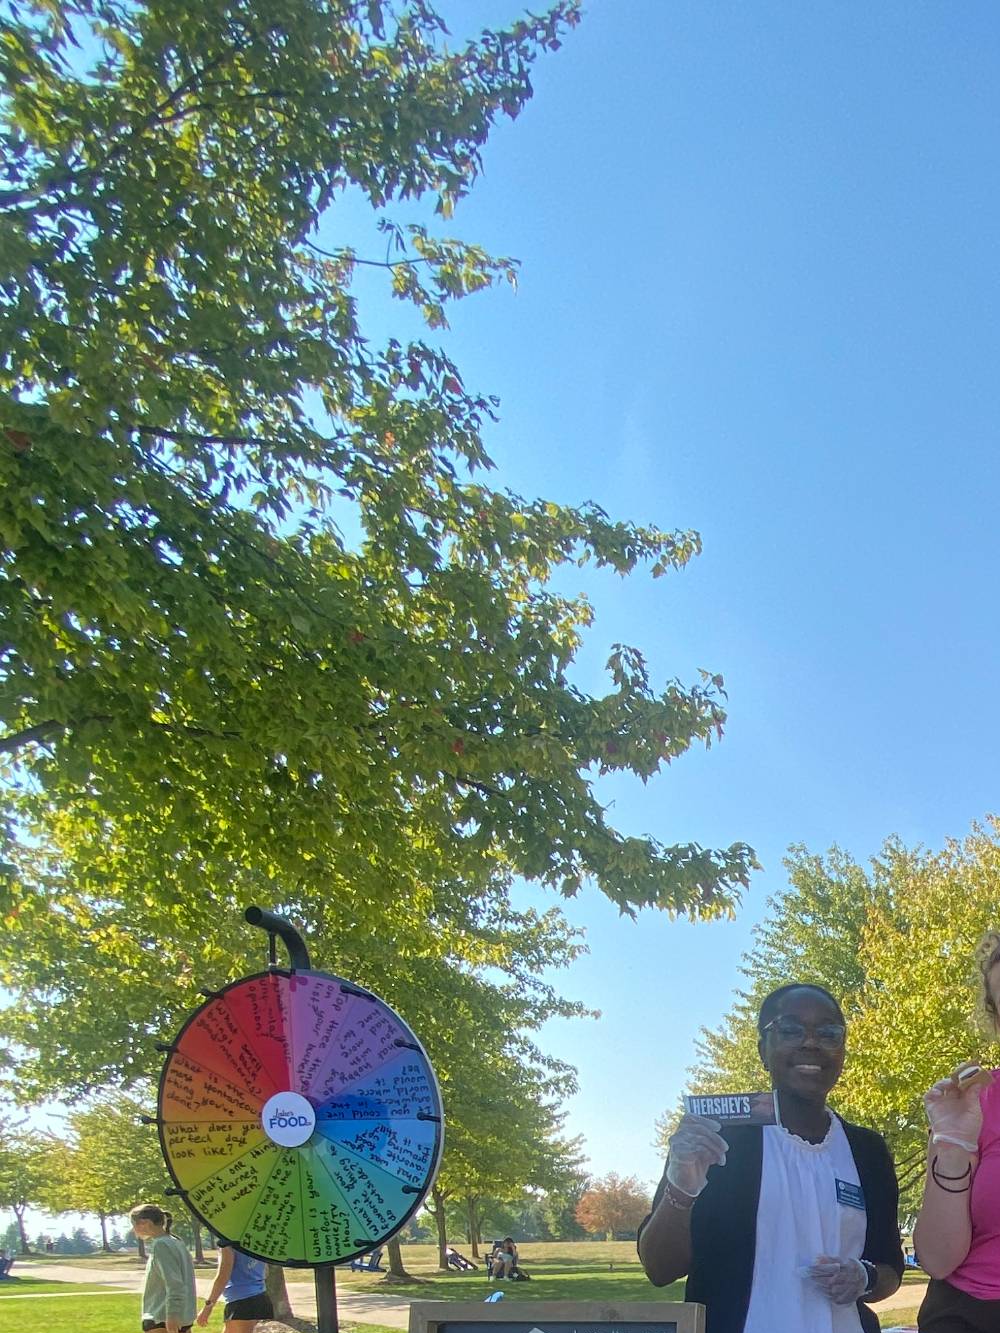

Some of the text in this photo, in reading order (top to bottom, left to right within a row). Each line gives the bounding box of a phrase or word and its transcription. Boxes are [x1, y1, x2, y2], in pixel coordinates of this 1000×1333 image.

[285, 982, 324, 1014] list?
[324, 985, 334, 998] on
[215, 1003, 237, 1034] What
[312, 1010, 324, 1035] your
[357, 1009, 380, 1028] time
[206, 1010, 257, 1080] brings back
[318, 1020, 338, 1048] three
[340, 1018, 390, 1058] had more
[324, 1024, 396, 1086] you wish you
[174, 1058, 244, 1100] What is the
[220, 1041, 261, 1096] memories?
[339, 1059, 372, 1084] hobby
[375, 1076, 425, 1086] would it
[401, 1065, 419, 1074] be?
[166, 1091, 203, 1112] done?
[167, 1078, 233, 1118] thing you've
[323, 1086, 333, 1095] do
[357, 1088, 390, 1096] where
[375, 1092, 430, 1105] anywhere
[325, 1111, 345, 1120] live
[351, 1110, 380, 1119] could
[391, 1103, 410, 1115] you
[693, 1096, 751, 1115] HERSHEY'S
[168, 1125, 198, 1136] What
[208, 1123, 232, 1132] does
[269, 1116, 307, 1128] FOOD
[169, 1135, 212, 1146] perfect
[171, 1143, 233, 1158] look like?
[354, 1134, 376, 1151] food
[361, 1129, 427, 1163] growing up?
[403, 1138, 411, 1146] it
[417, 1144, 430, 1155] Is
[192, 1176, 222, 1201] What's
[229, 1161, 246, 1174] one
[250, 1138, 278, 1158] thing
[341, 1139, 420, 1182] What was your
[199, 1166, 258, 1214] you learned
[279, 1170, 291, 1186] the
[330, 1145, 388, 1229] favorite thing to
[208, 1176, 260, 1218] this week?
[334, 1172, 379, 1236] What's your
[350, 1162, 396, 1221] do outside?
[243, 1168, 281, 1247] If you had to
[276, 1191, 293, 1220] which
[306, 1170, 321, 1256] What is your
[320, 1210, 332, 1256] comfort
[330, 1203, 340, 1256] movie/TV
[339, 1212, 350, 1247] show?
[268, 1240, 279, 1256] one
